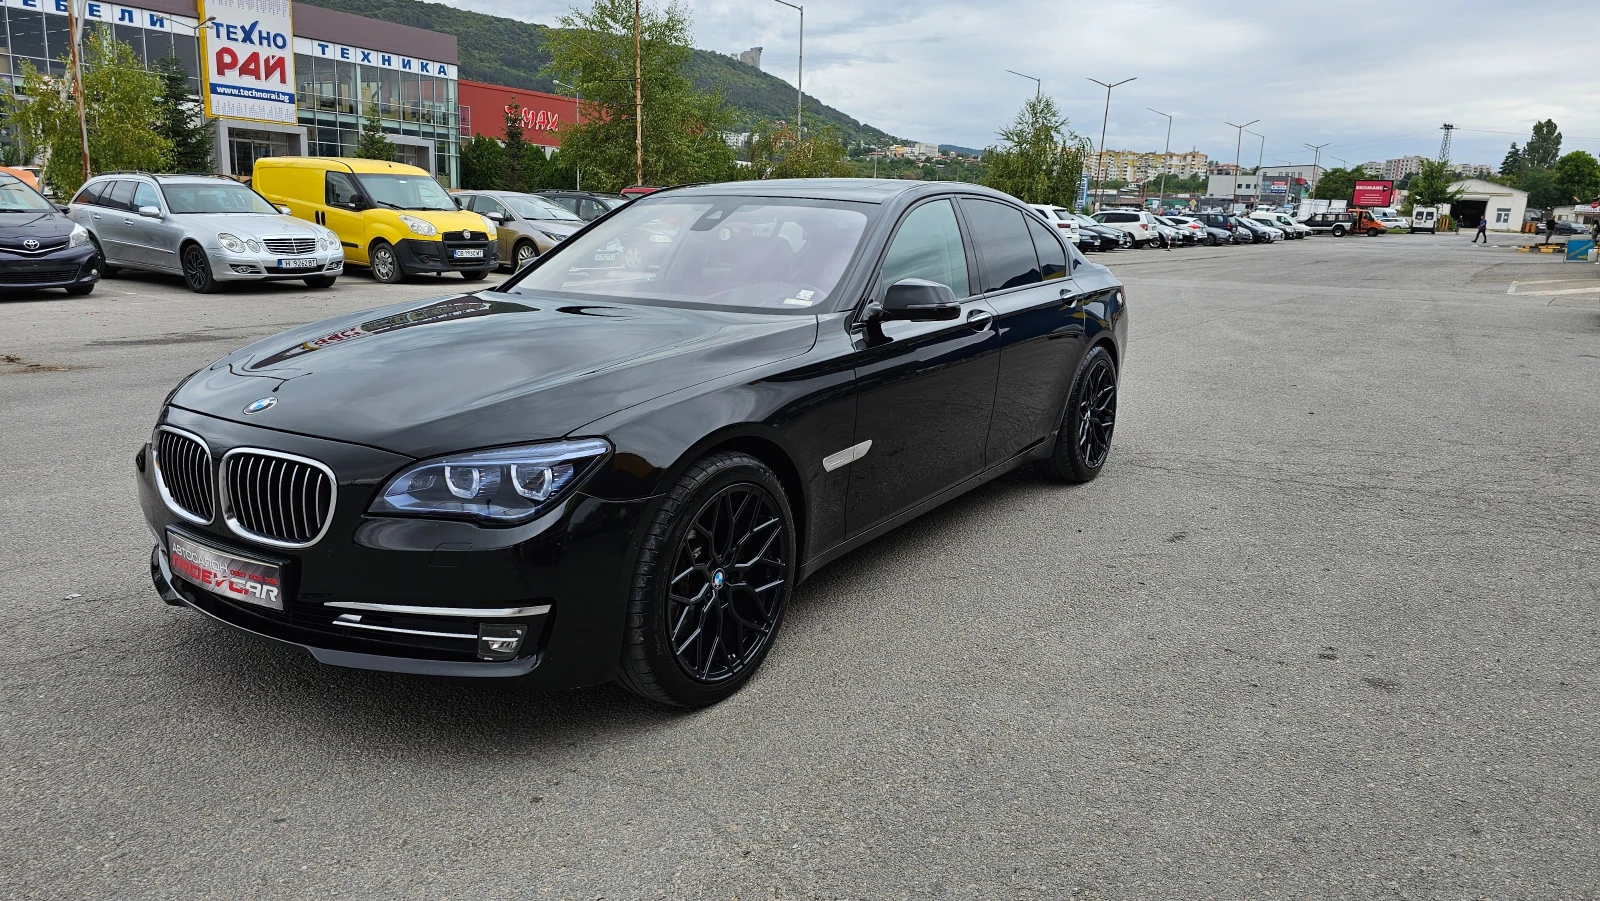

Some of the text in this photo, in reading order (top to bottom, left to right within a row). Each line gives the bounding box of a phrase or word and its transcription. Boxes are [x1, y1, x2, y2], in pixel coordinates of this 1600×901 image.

[0, 0, 165, 29] ЕБЕЛИ
[211, 20, 287, 50] ТЕХНО
[215, 47, 287, 84] РАЙ
[317, 43, 448, 76] ТЕХНИКА
[216, 86, 290, 102] www.technorai.bg
[172, 542, 229, 573] АВТОСАЛОН
